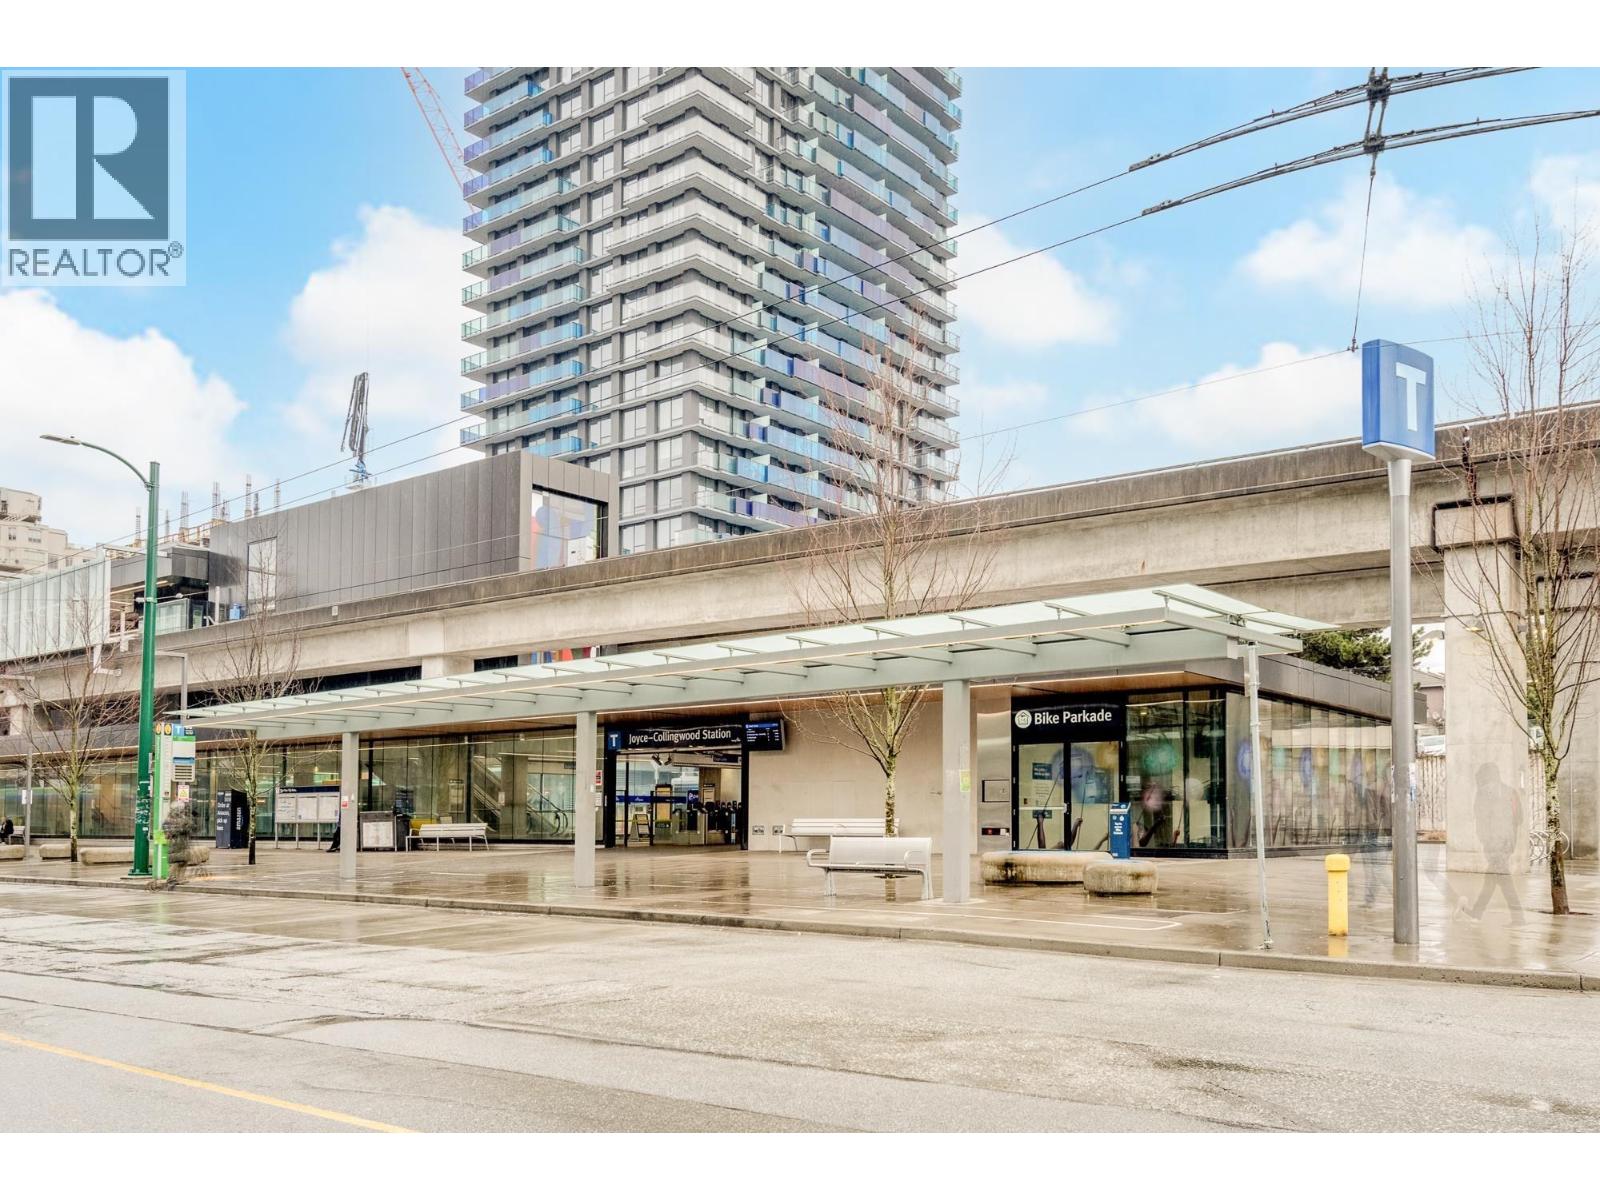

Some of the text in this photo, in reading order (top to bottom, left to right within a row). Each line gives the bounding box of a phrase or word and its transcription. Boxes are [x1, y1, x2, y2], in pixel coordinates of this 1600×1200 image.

[1395, 362, 1427, 432] T
[1034, 708, 1112, 725] Bike Parkade
[609, 733, 619, 747] T
[702, 728, 732, 740] Station
